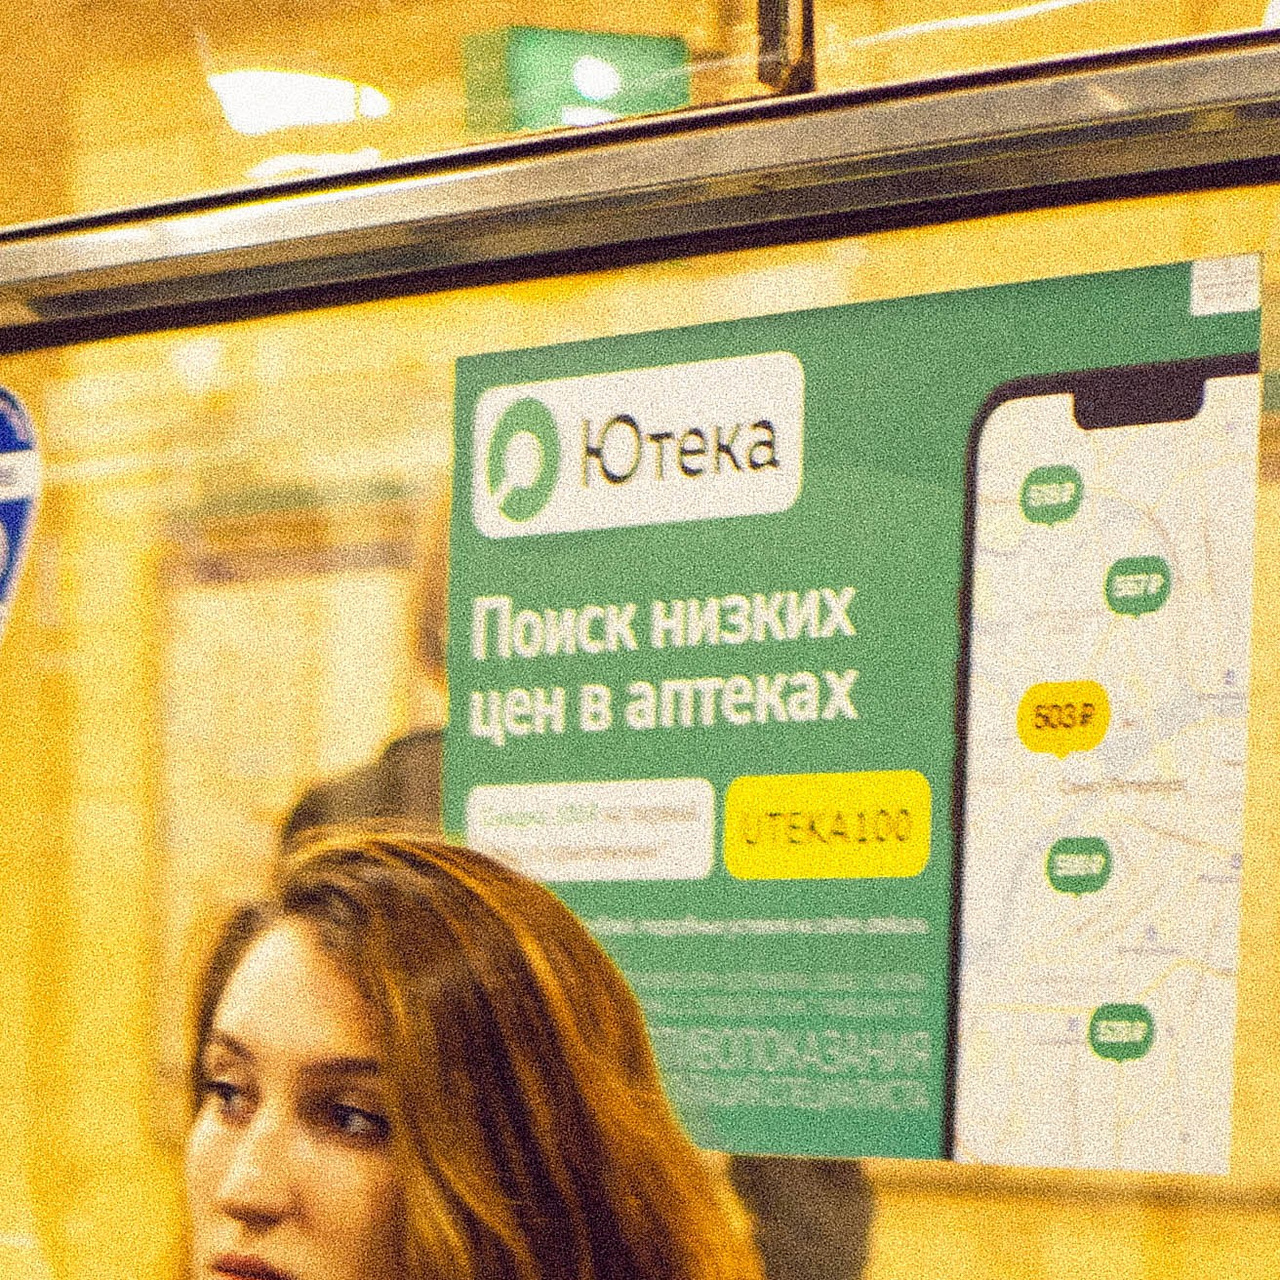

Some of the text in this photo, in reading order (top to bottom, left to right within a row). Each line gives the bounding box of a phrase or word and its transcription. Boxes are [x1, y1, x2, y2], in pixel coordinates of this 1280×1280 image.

[581, 413, 780, 486] Ютека
[471, 586, 858, 660] Поиск низких
[469, 670, 859, 746] цен в аптеках
[740, 808, 913, 846] UTEKA100
